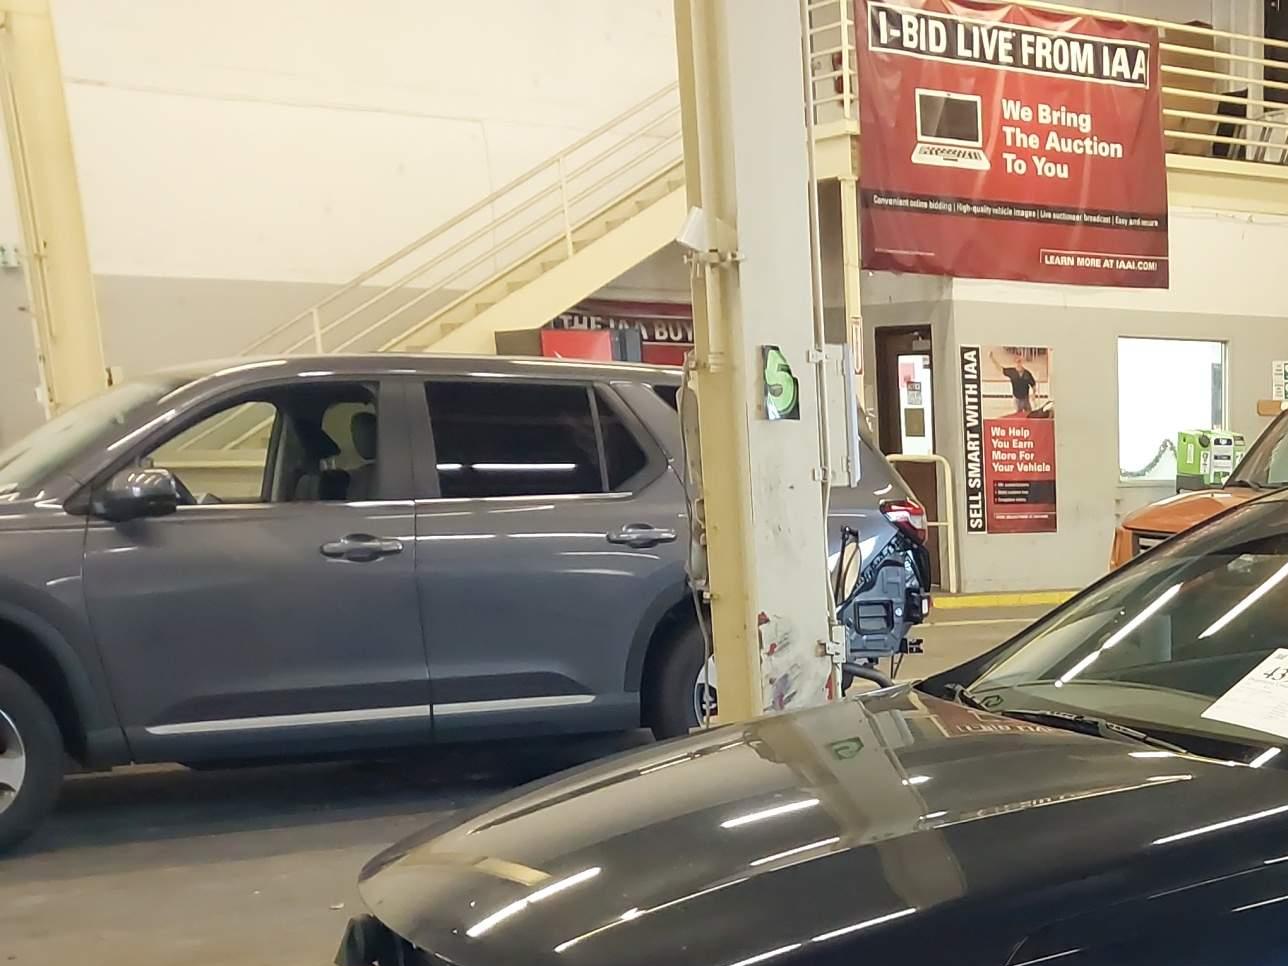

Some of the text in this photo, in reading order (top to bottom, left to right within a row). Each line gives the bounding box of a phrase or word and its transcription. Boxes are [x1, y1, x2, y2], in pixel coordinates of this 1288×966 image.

[878, 10, 1146, 82] I-BID LIVE FROM IAA
[1002, 98, 1092, 133] We Bring
[1002, 126, 1123, 158] The Auction
[1002, 152, 1069, 178] To You
[1044, 254, 1075, 266] LEARN
[1076, 256, 1101, 269] MORE
[1102, 259, 1114, 270] AT
[963, 350, 983, 529] SELL SMART WITH IAA
[991, 426, 1030, 439] We Help
[991, 439, 1034, 449] You Earn
[992, 450, 1035, 461] More For
[992, 462, 1051, 472] Your Vehicle
